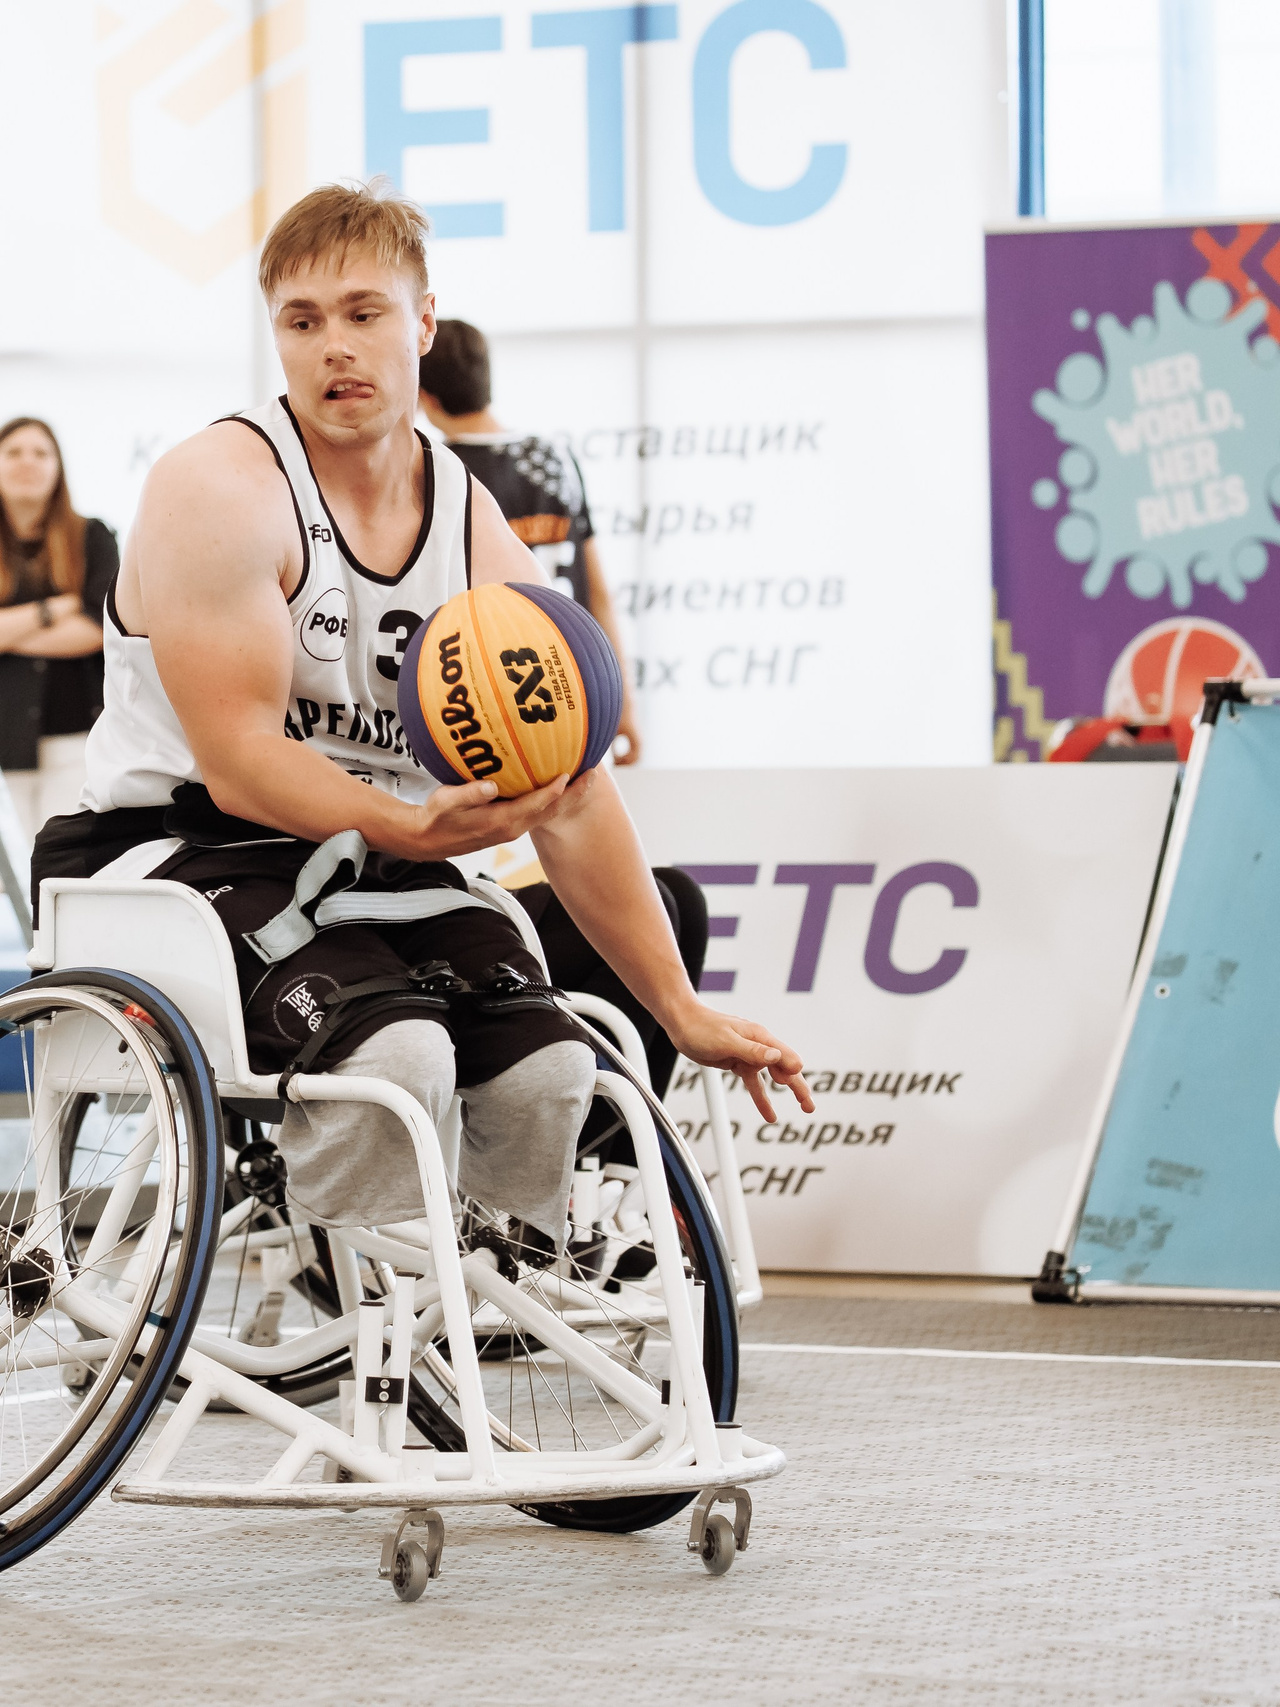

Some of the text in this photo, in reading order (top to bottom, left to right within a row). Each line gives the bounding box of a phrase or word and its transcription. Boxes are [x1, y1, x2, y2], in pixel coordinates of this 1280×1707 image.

[1132, 352, 1203, 405] HER
[1149, 438, 1220, 490] HER
[1137, 474, 1249, 540] RULES
[548, 644, 576, 711] OFFICIAL BALL
[552, 678, 564, 701] FIBA
[706, 643, 819, 690] СНГ
[439, 631, 503, 780] Wilson
[756, 1121, 896, 1152] сырья
[739, 1165, 825, 1197] СНГ
